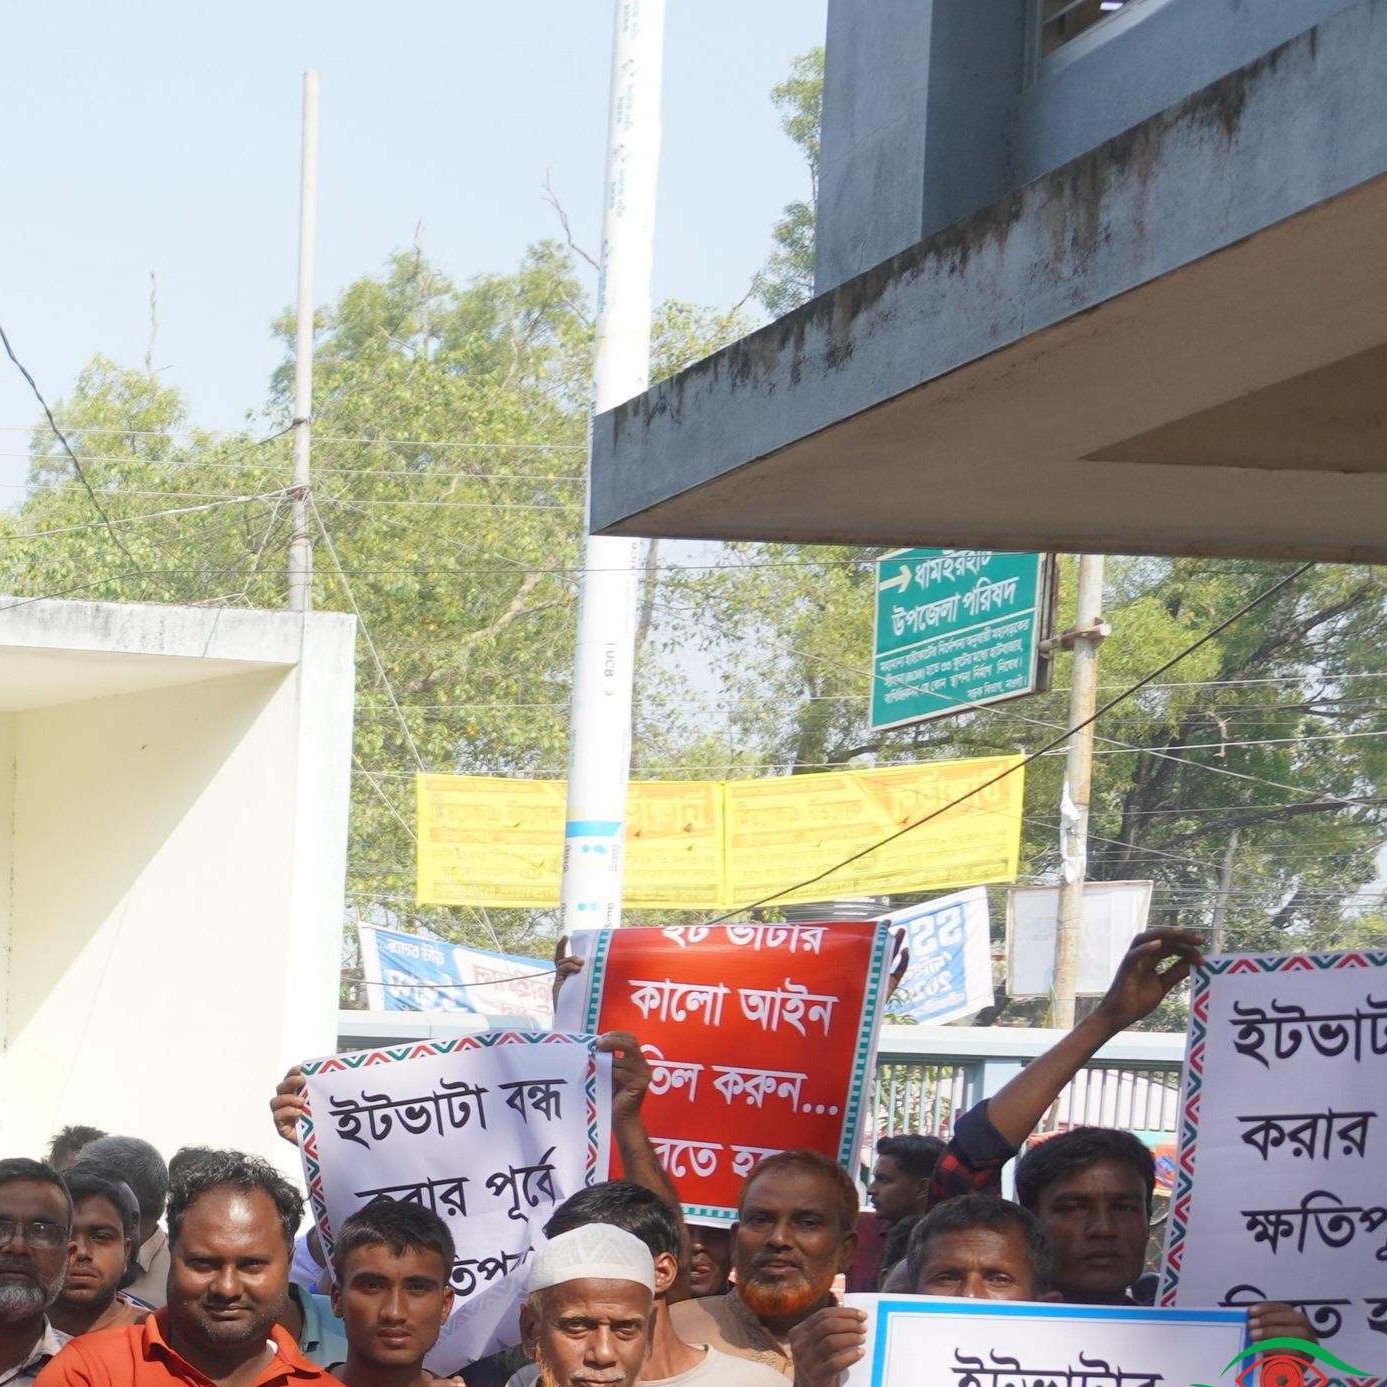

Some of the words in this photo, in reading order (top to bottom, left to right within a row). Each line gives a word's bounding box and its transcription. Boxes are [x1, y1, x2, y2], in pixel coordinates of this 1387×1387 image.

[891, 593, 960, 636] উপজেলা
[963, 577, 1019, 616] পরিষদ
[627, 978, 731, 1026] কালো
[738, 977, 839, 1037] আইন
[328, 1079, 489, 1150] ইটভাটা
[501, 1076, 568, 1128] বন্ধ
[711, 1064, 839, 1116] করুন...
[1236, 1106, 1377, 1161] করার
[485, 1146, 557, 1223] পূর্বে
